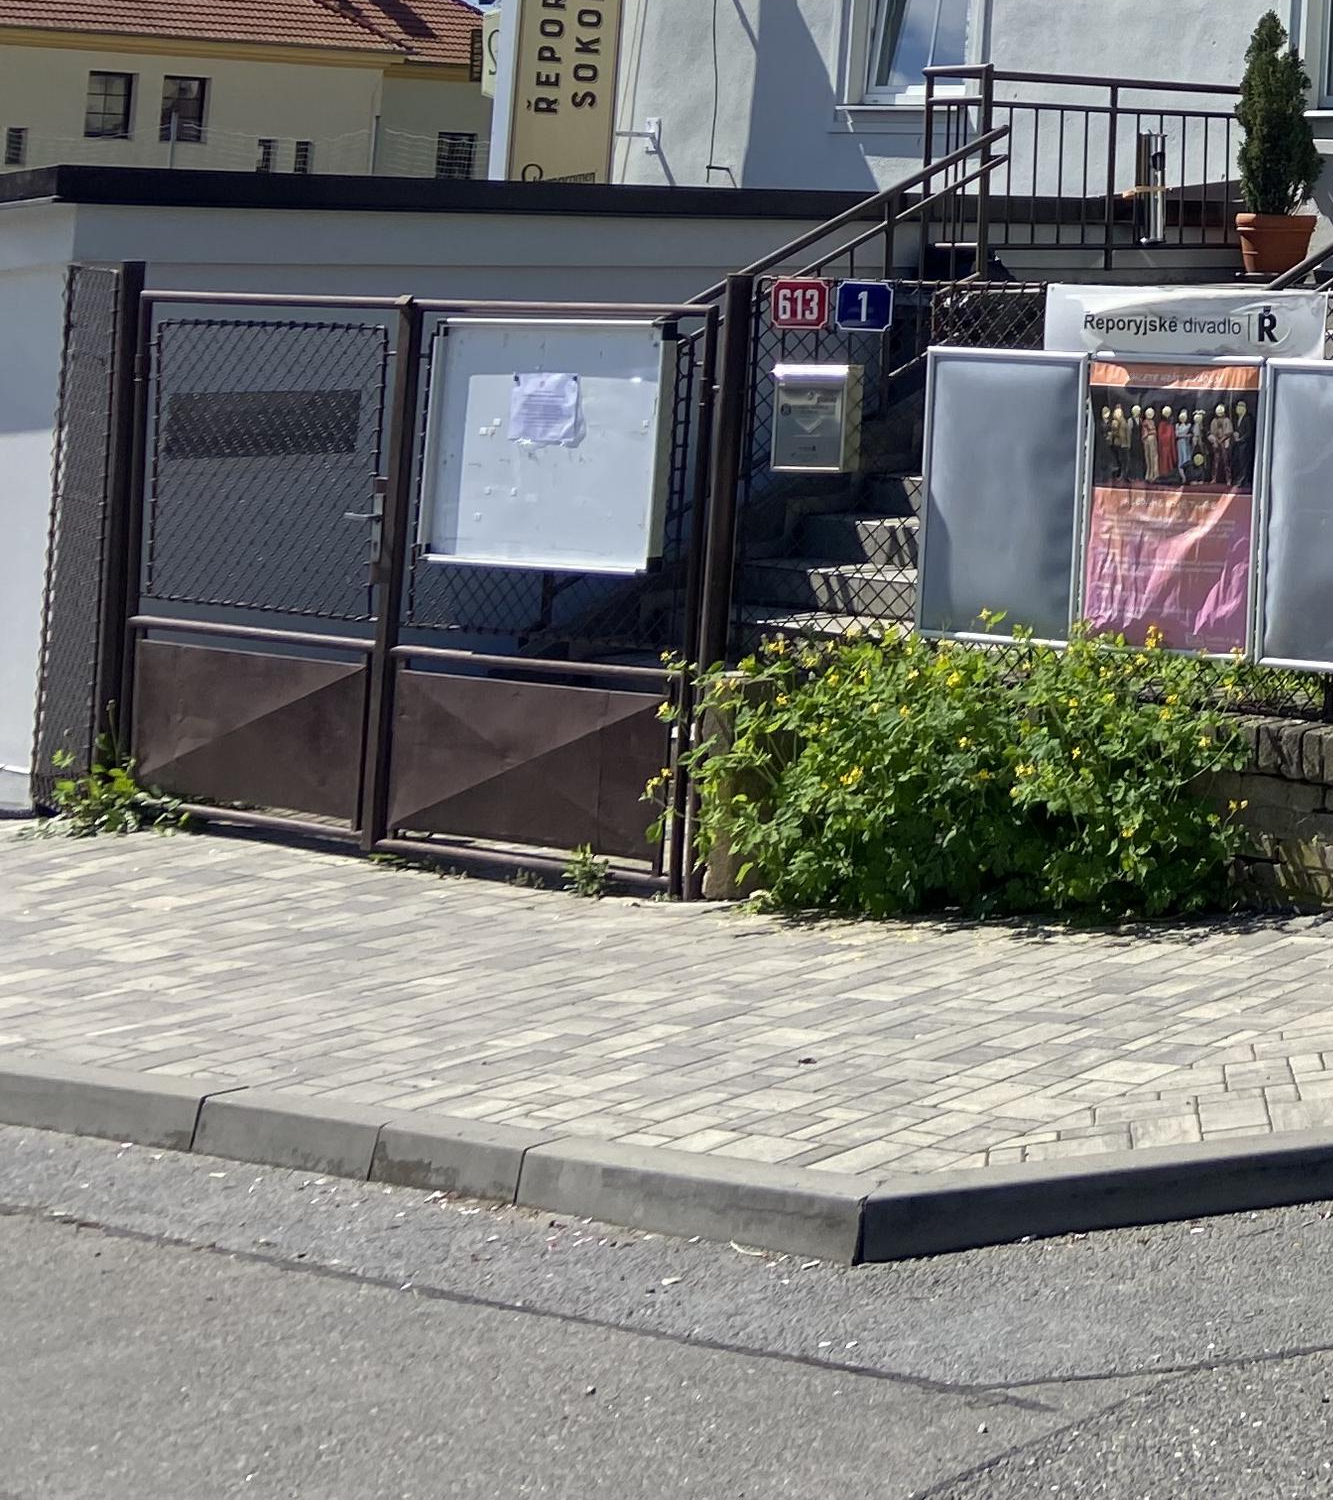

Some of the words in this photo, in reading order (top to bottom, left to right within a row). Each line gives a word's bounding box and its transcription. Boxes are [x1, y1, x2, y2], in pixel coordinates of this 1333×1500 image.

[778, 288, 819, 321] 613
[857, 290, 869, 323] 1
[1183, 318, 1242, 336] divadlo
